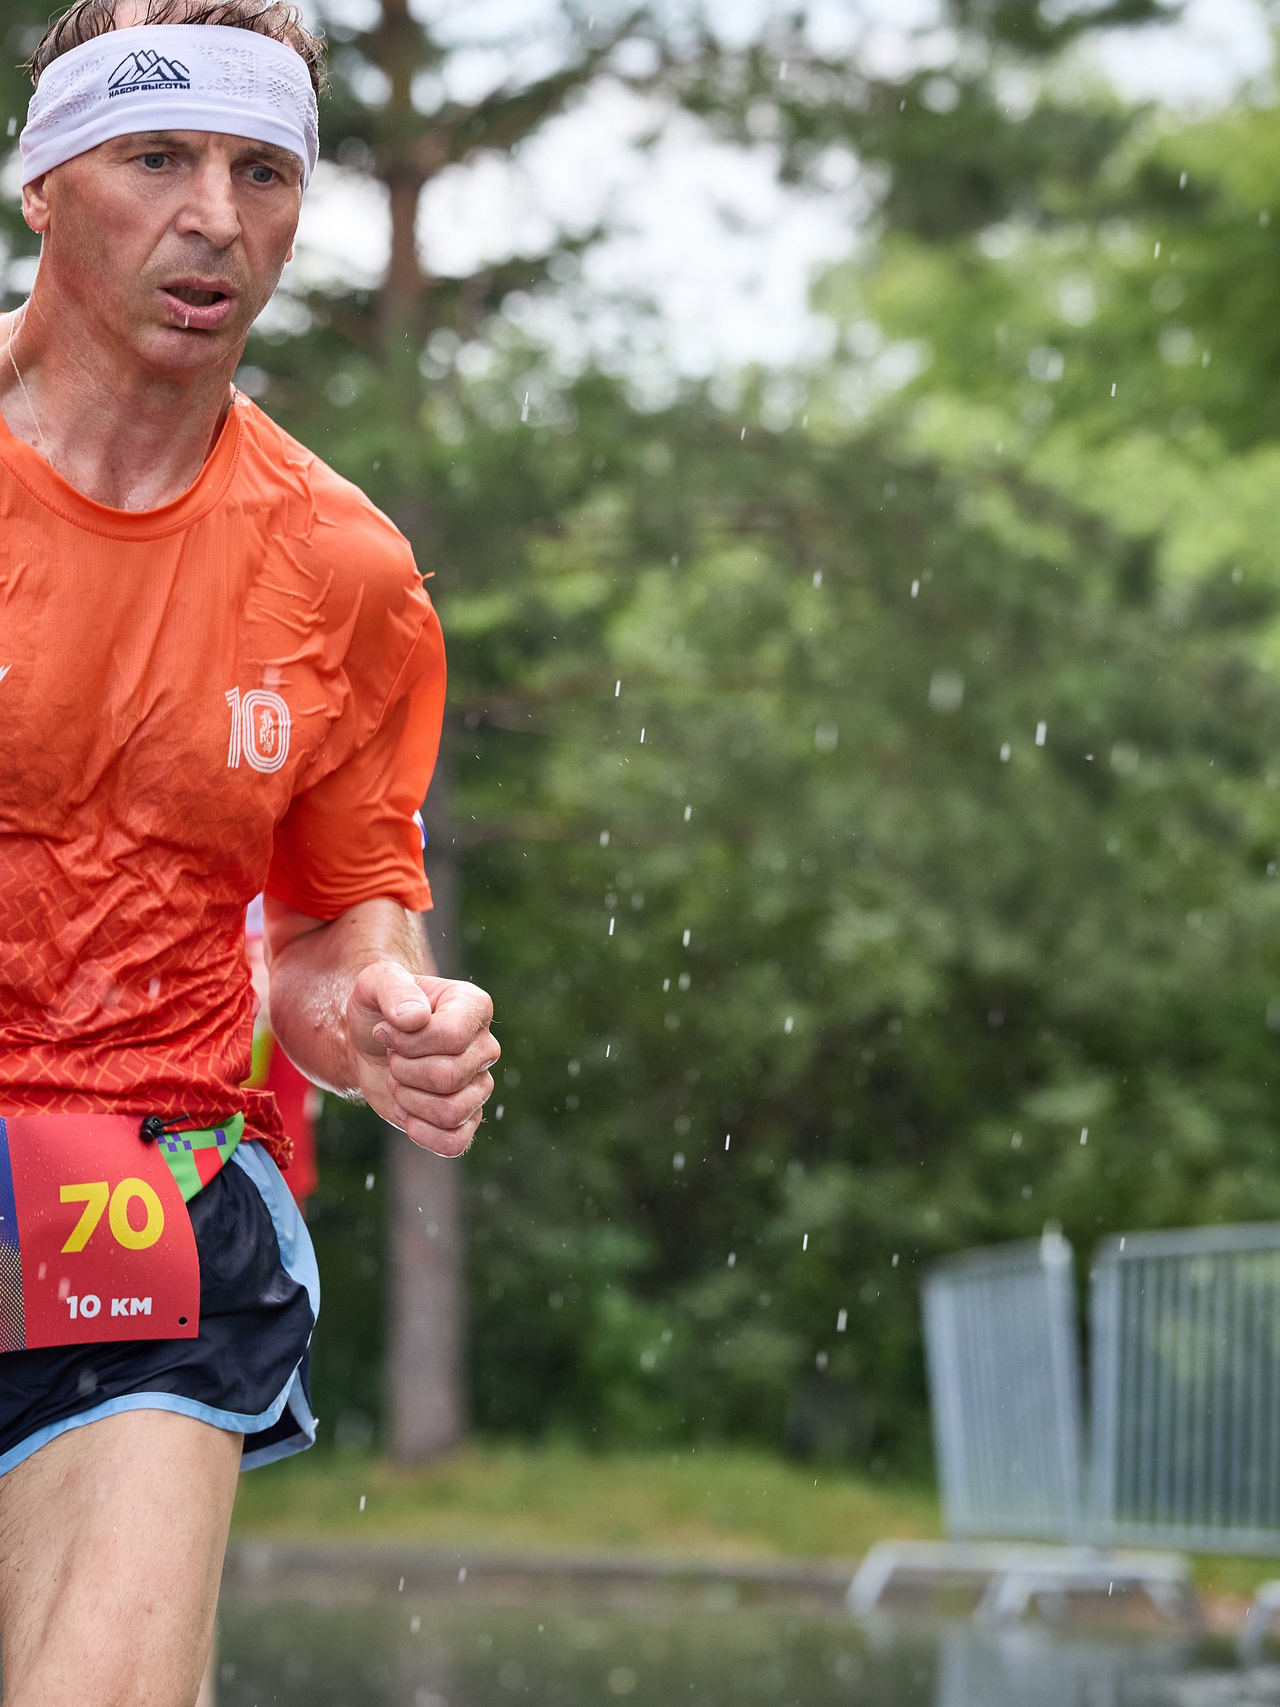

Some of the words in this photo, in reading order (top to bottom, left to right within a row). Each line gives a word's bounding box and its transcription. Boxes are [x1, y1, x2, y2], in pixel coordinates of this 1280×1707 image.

[108, 87, 140, 98] НАБОР
[141, 83, 190, 91] ВЫСОТЫ
[224, 685, 291, 774] 10
[59, 1177, 165, 1254] 70
[65, 1294, 102, 1320] 10
